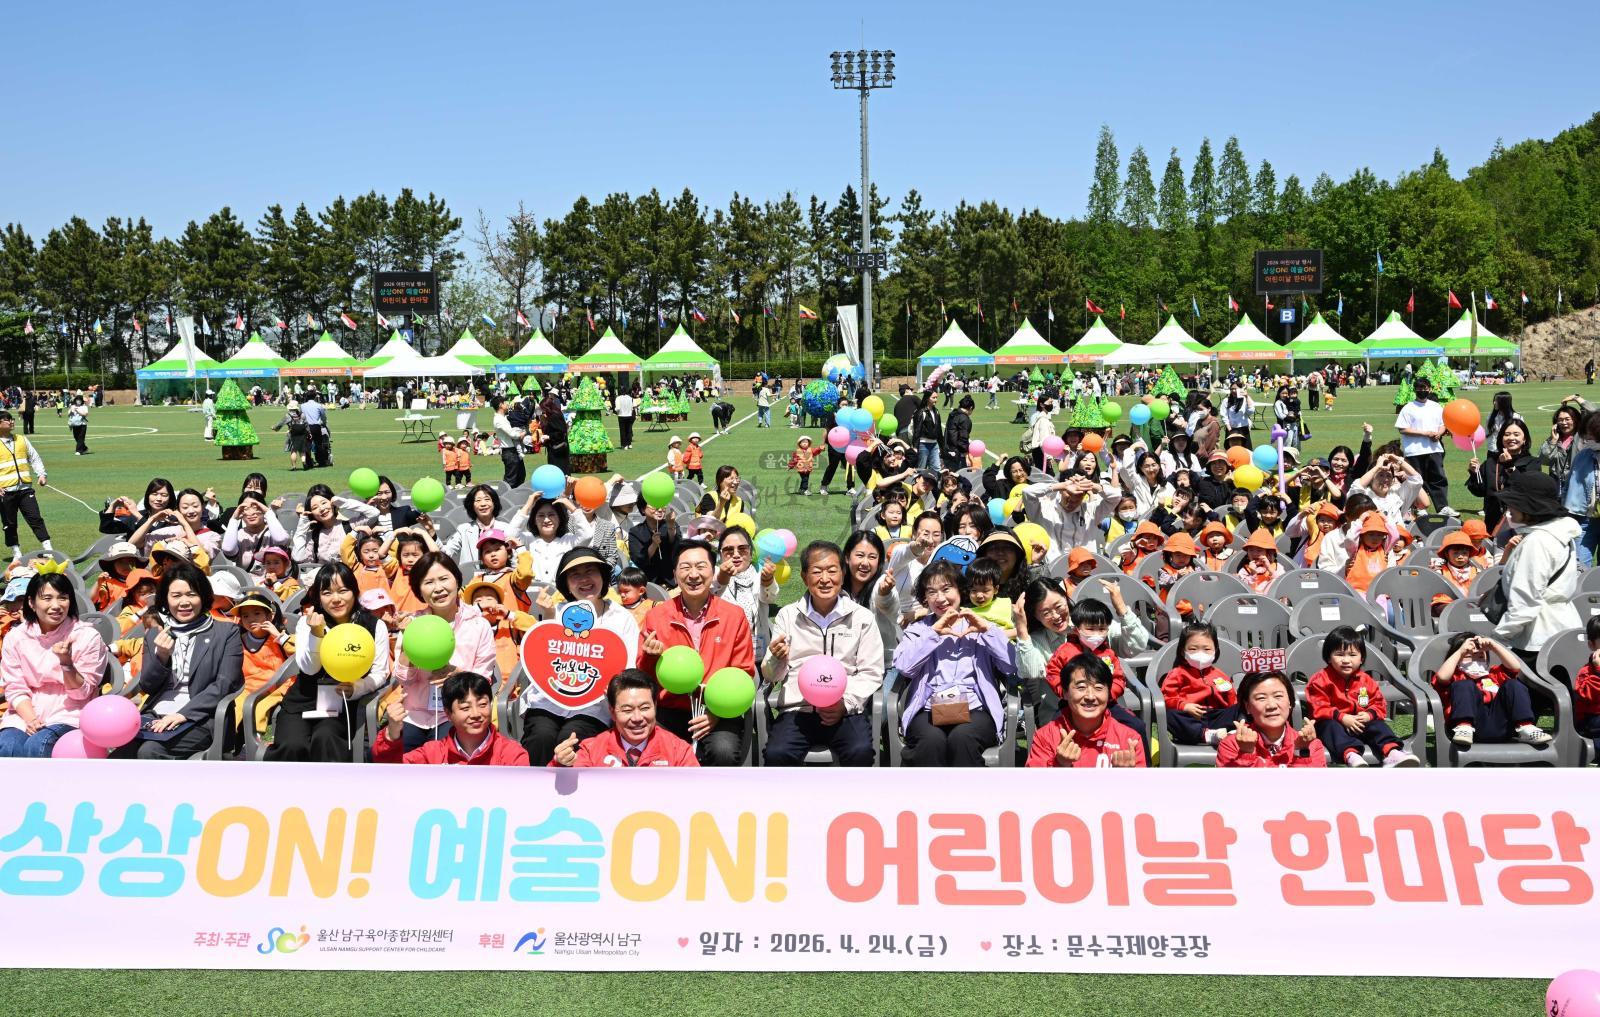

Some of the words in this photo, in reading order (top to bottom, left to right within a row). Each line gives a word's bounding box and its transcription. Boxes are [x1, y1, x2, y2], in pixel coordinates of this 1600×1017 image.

[1263, 267, 1288, 275] 상상ON!
[1290, 266, 1316, 274] 예술ON!
[1265, 275, 1291, 283] 어린이날
[1294, 274, 1314, 282] 한마당
[379, 288, 404, 296] 상상ON!
[405, 288, 431, 296] 예술ON!
[382, 296, 407, 304] 어린이날
[409, 296, 429, 304] 한마당
[1282, 310, 1293, 321] B
[402, 331, 411, 342] A
[547, 638, 605, 659] 함께해요
[1242, 655, 1286, 672] 이양임
[0, 801, 378, 899] 상상ON!
[408, 807, 789, 903] 예술ON!
[826, 811, 1238, 906] 어린이날
[1263, 811, 1594, 906] 한마당
[318, 928, 340, 942] 울산
[479, 932, 505, 949] 후원
[555, 931, 615, 947] 울산광역시
[617, 932, 642, 947] 남구
[700, 931, 744, 956] 일자
[753, 935, 760, 949] :
[771, 934, 832, 954] 2026.
[841, 935, 860, 954] 4.
[1003, 934, 1045, 958] 장소
[1051, 938, 1058, 951] :
[1066, 934, 1212, 959] 문수국제양궁장
[555, 948, 575, 956] Namgu
[593, 948, 628, 956] Metropolitan
[629, 948, 640, 957] City
